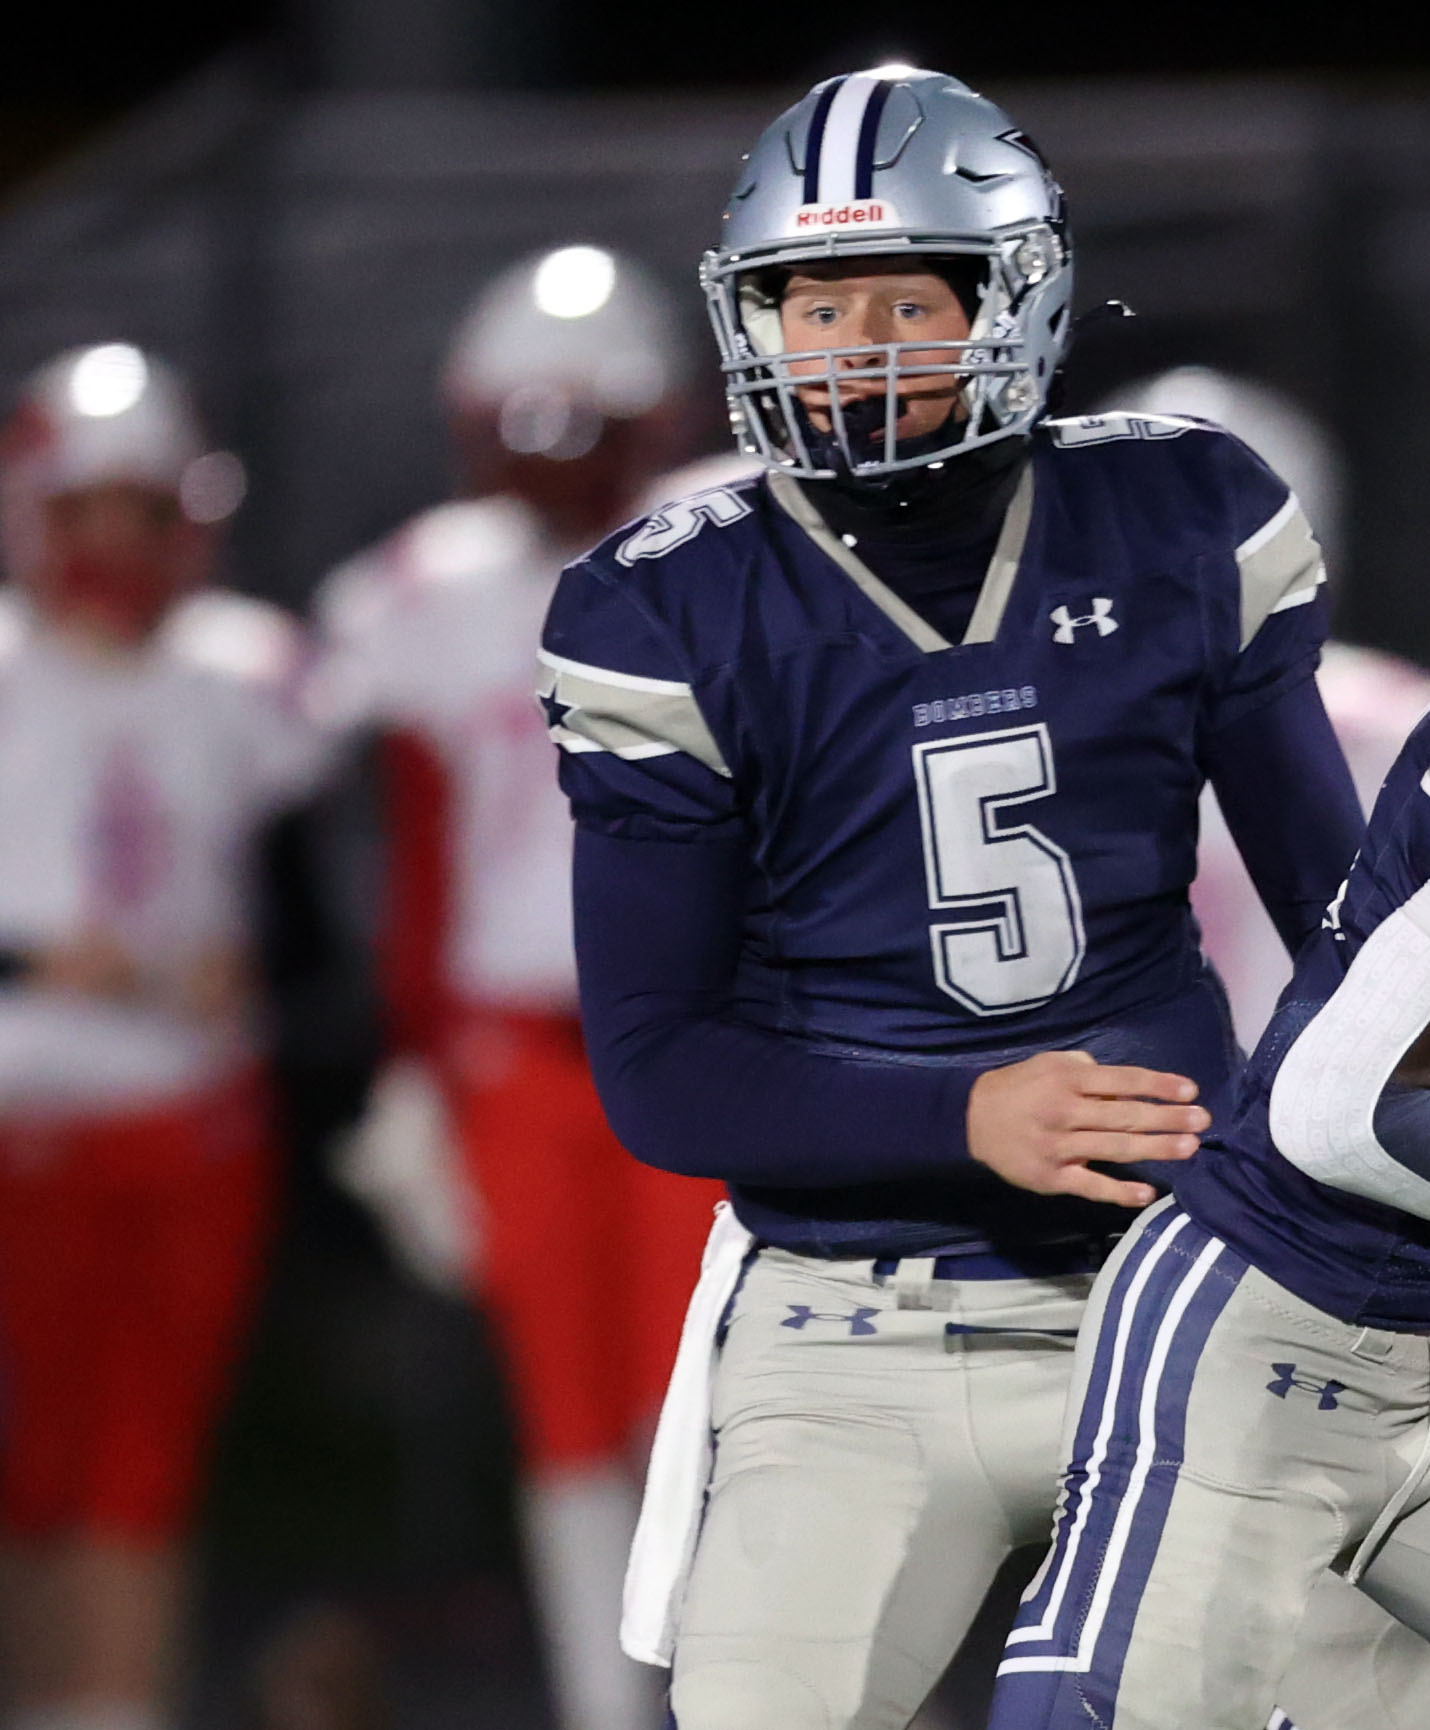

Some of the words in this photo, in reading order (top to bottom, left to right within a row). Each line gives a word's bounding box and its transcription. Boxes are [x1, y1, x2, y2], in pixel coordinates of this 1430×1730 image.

[797, 204, 883, 226] Riddell
[615, 486, 755, 567] 5
[912, 685, 1038, 727] BOMBERS
[911, 722, 1086, 1017] 5
